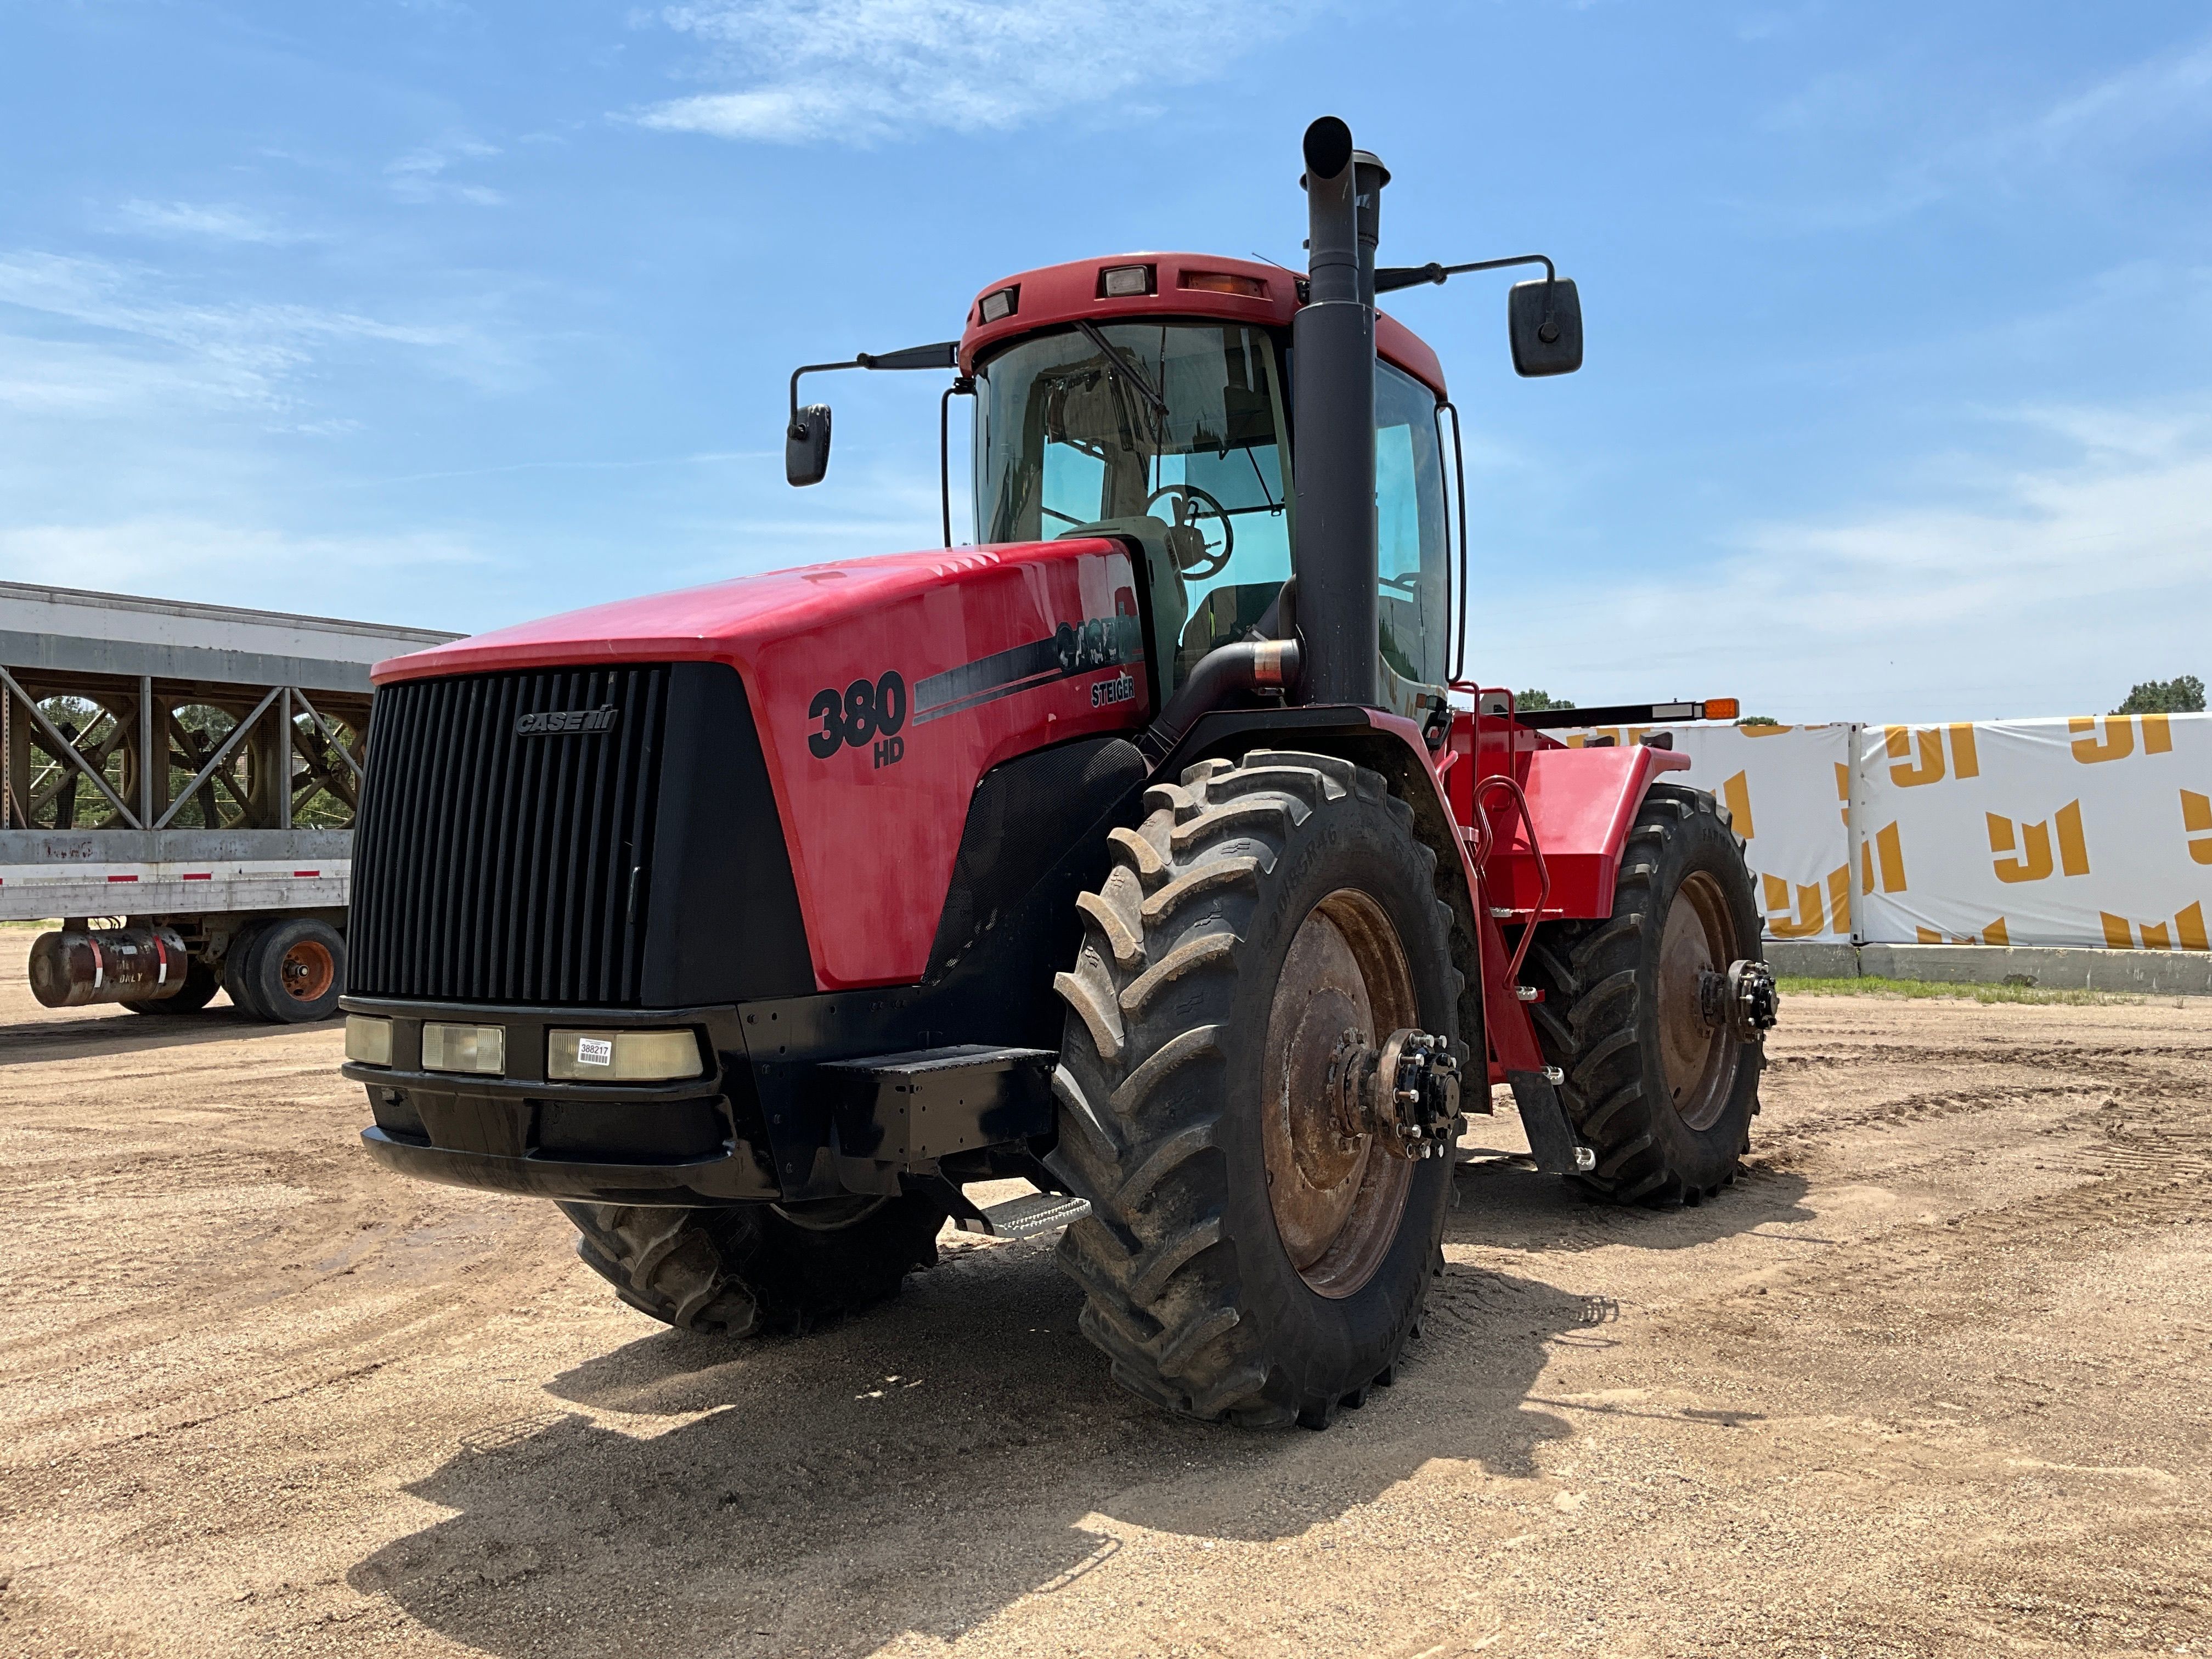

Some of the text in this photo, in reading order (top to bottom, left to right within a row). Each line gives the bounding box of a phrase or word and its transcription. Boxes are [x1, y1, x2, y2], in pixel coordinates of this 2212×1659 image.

[1091, 675, 1135, 708] STEIGER
[808, 670, 906, 759] 380
[874, 736, 905, 769] HD
[119, 972, 143, 983] ONLY
[581, 1044, 608, 1055] 388217
